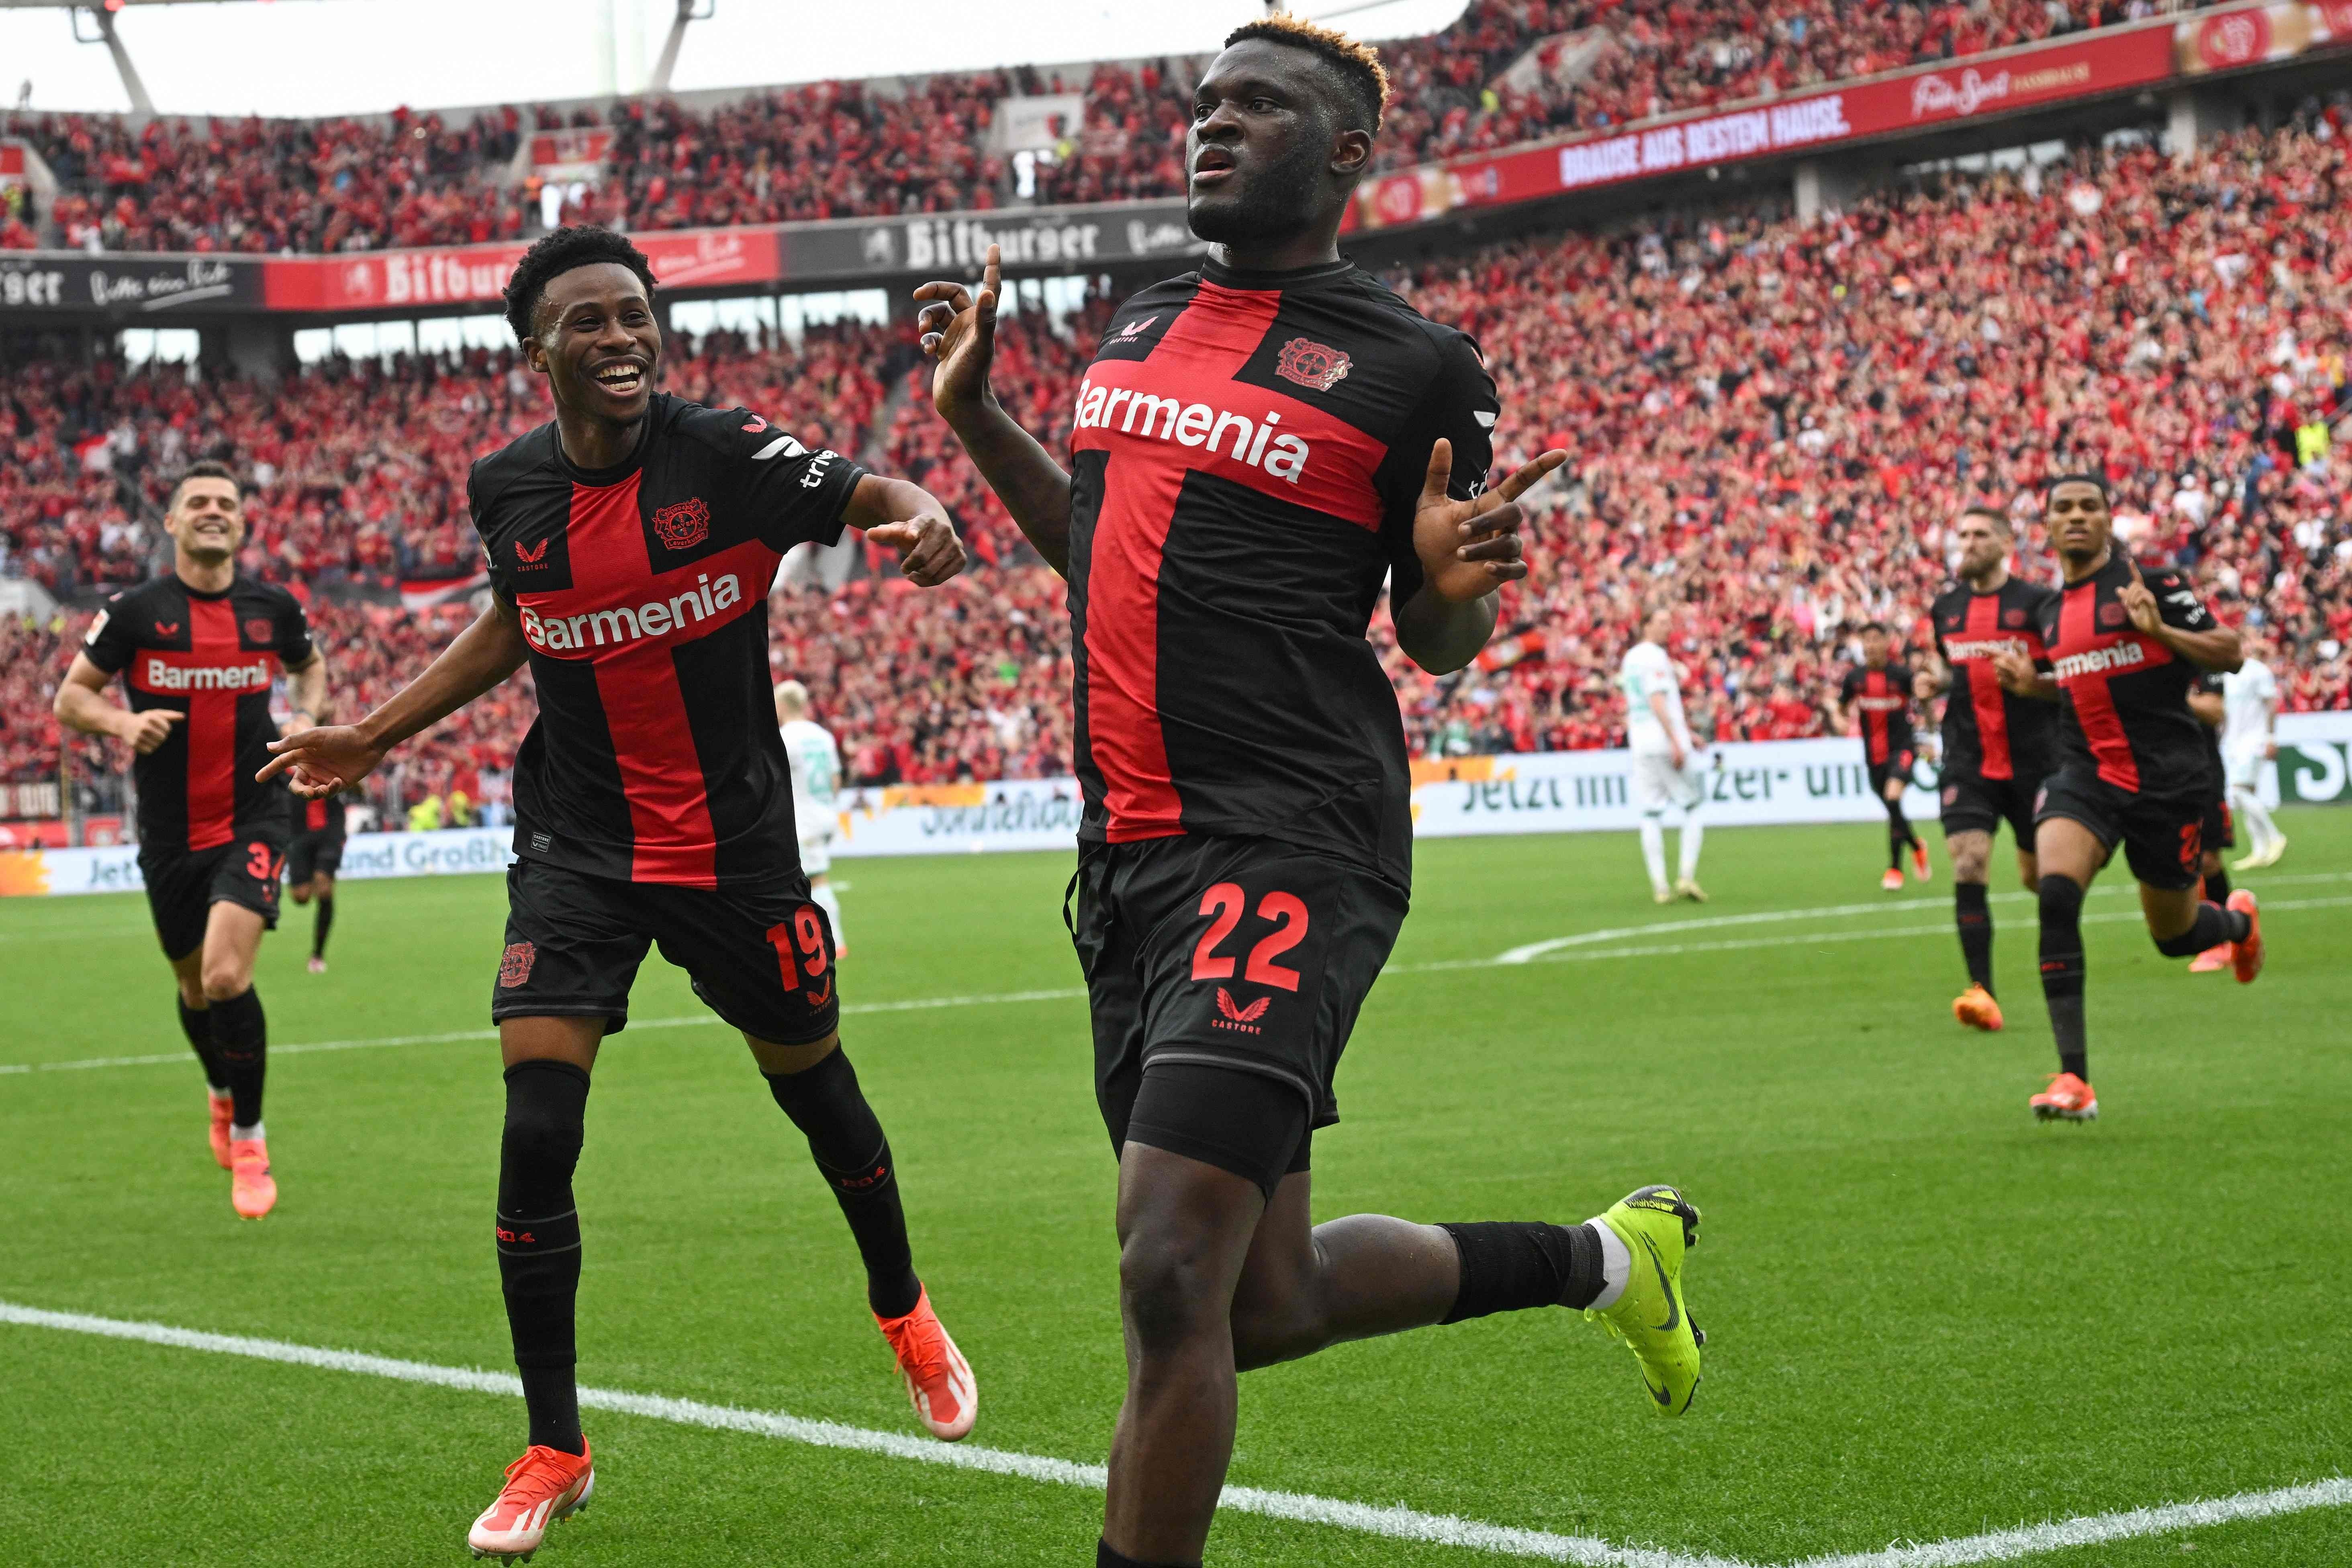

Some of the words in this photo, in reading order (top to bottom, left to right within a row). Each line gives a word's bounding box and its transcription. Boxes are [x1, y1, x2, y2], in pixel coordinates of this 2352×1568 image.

[1641, 125, 1684, 171] AUS
[1686, 108, 1769, 164] BESTEM
[908, 219, 1099, 270] Bitburger
[0, 270, 64, 305] ger
[386, 255, 516, 302] Bitbur
[1074, 379, 1309, 484] Barmenia
[668, 532, 705, 546] Leverkusen
[672, 520, 695, 530] BAYER
[517, 563, 549, 572] CASTORE
[523, 573, 741, 649] Barmenia
[90, 859, 133, 883] Jet
[766, 904, 827, 992] 19
[1191, 882, 1309, 992] 22
[1212, 1019, 1261, 1035] CASTORE
